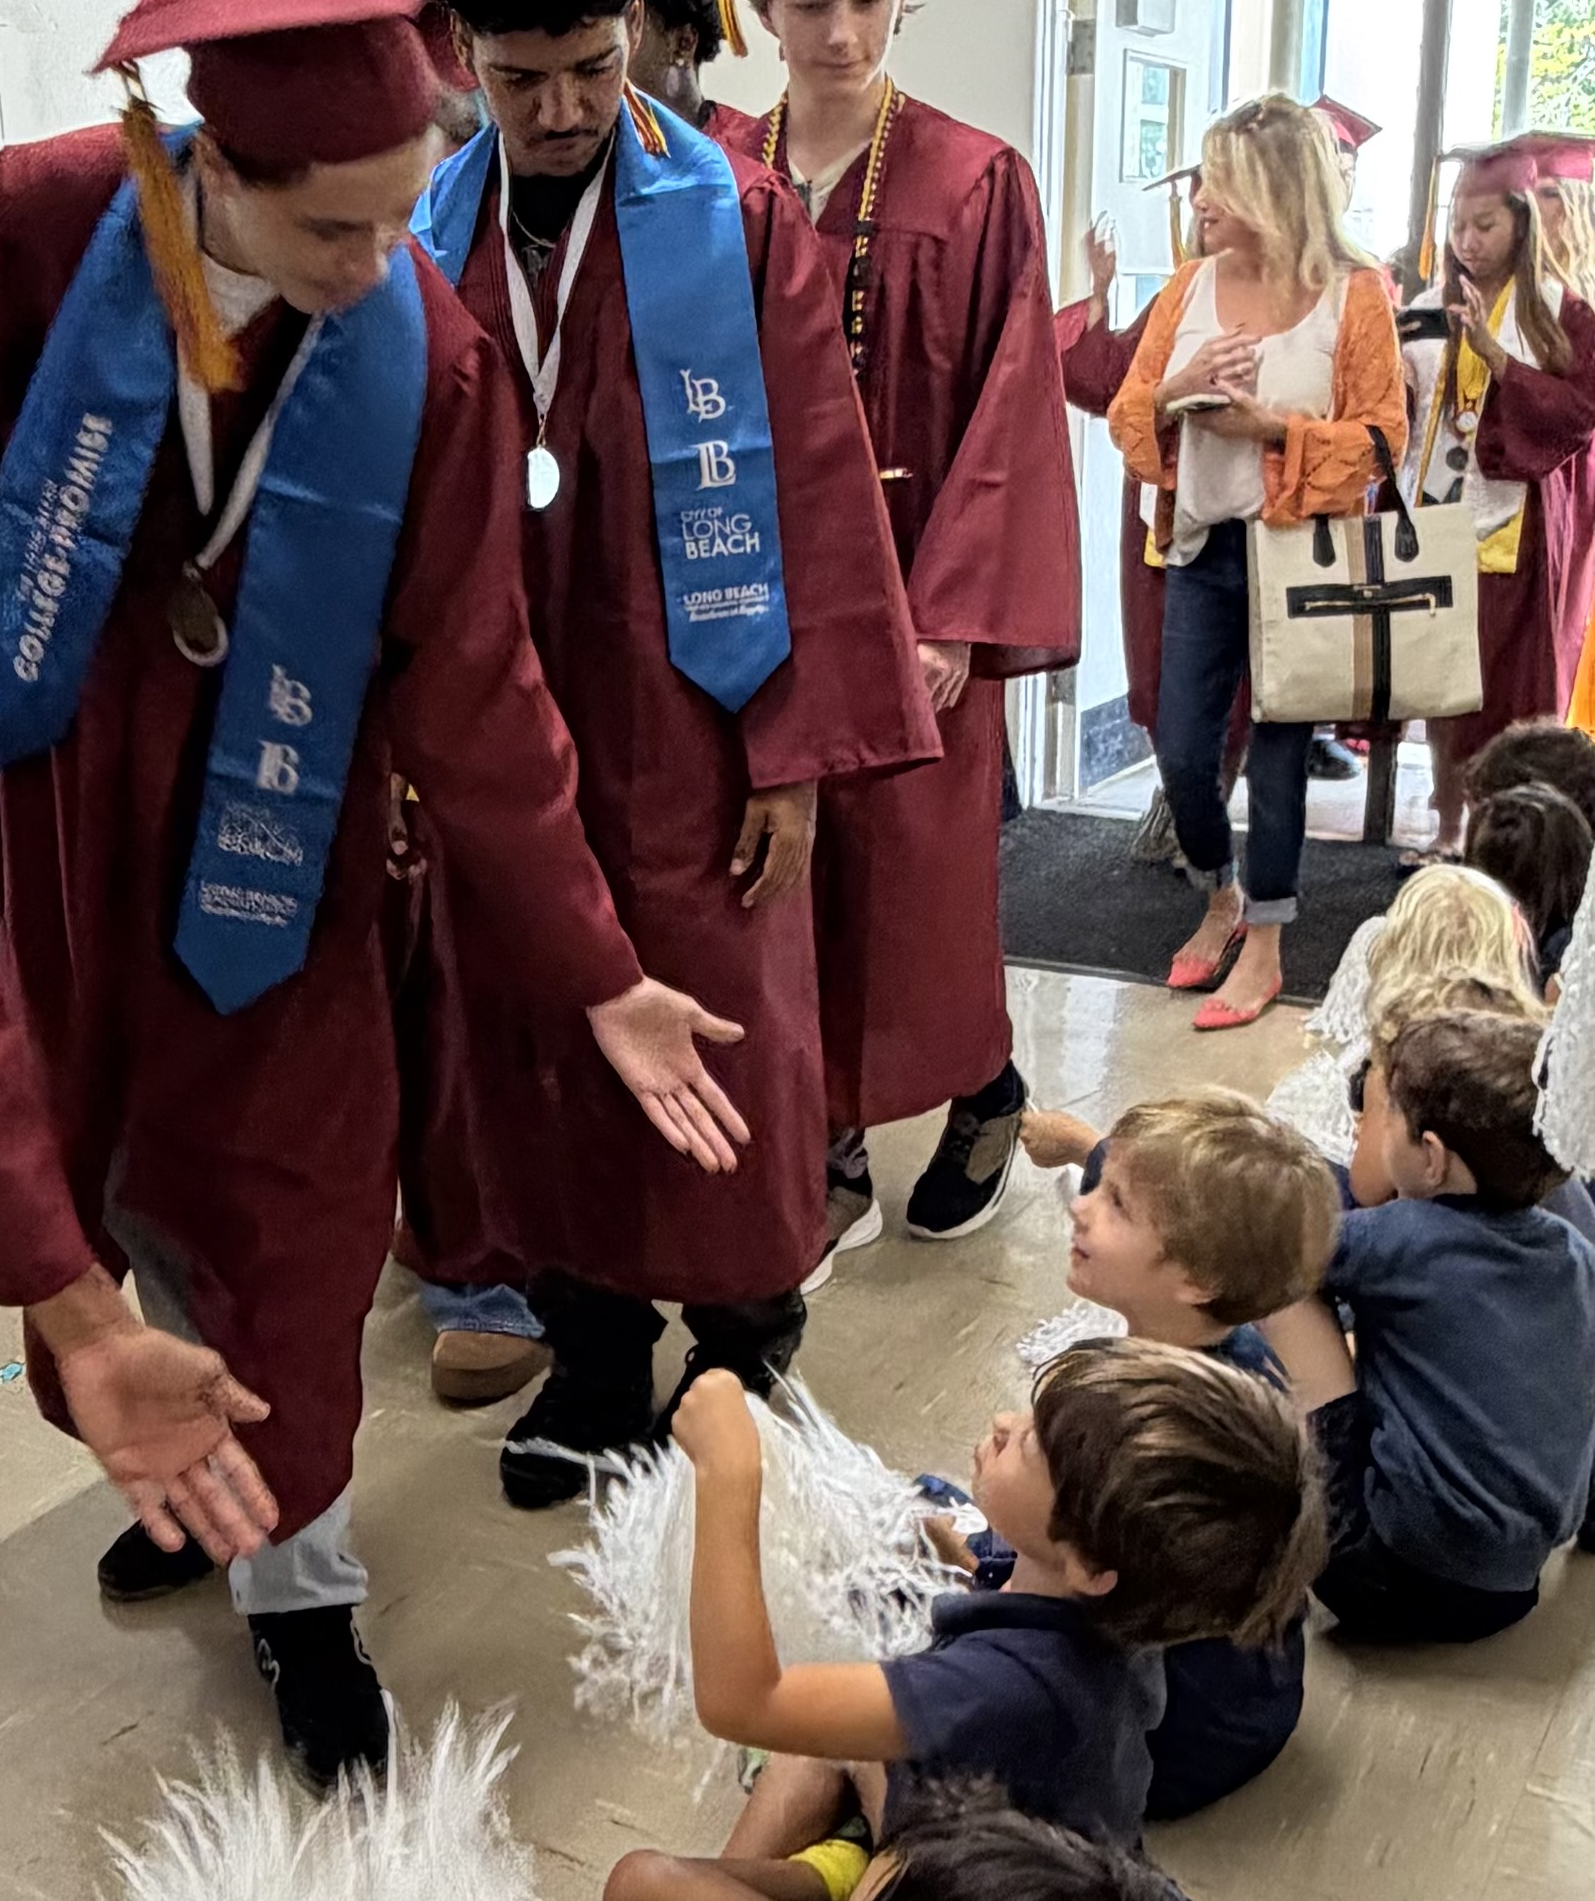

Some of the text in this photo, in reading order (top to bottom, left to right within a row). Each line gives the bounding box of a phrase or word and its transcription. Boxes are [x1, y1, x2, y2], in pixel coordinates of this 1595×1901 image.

[679, 368, 726, 423] LB
[688, 440, 737, 491] LB
[12, 550, 70, 684] COLLEGE
[48, 411, 114, 550] PROMISE
[681, 513, 753, 540] LONG
[685, 531, 761, 560] BEACH
